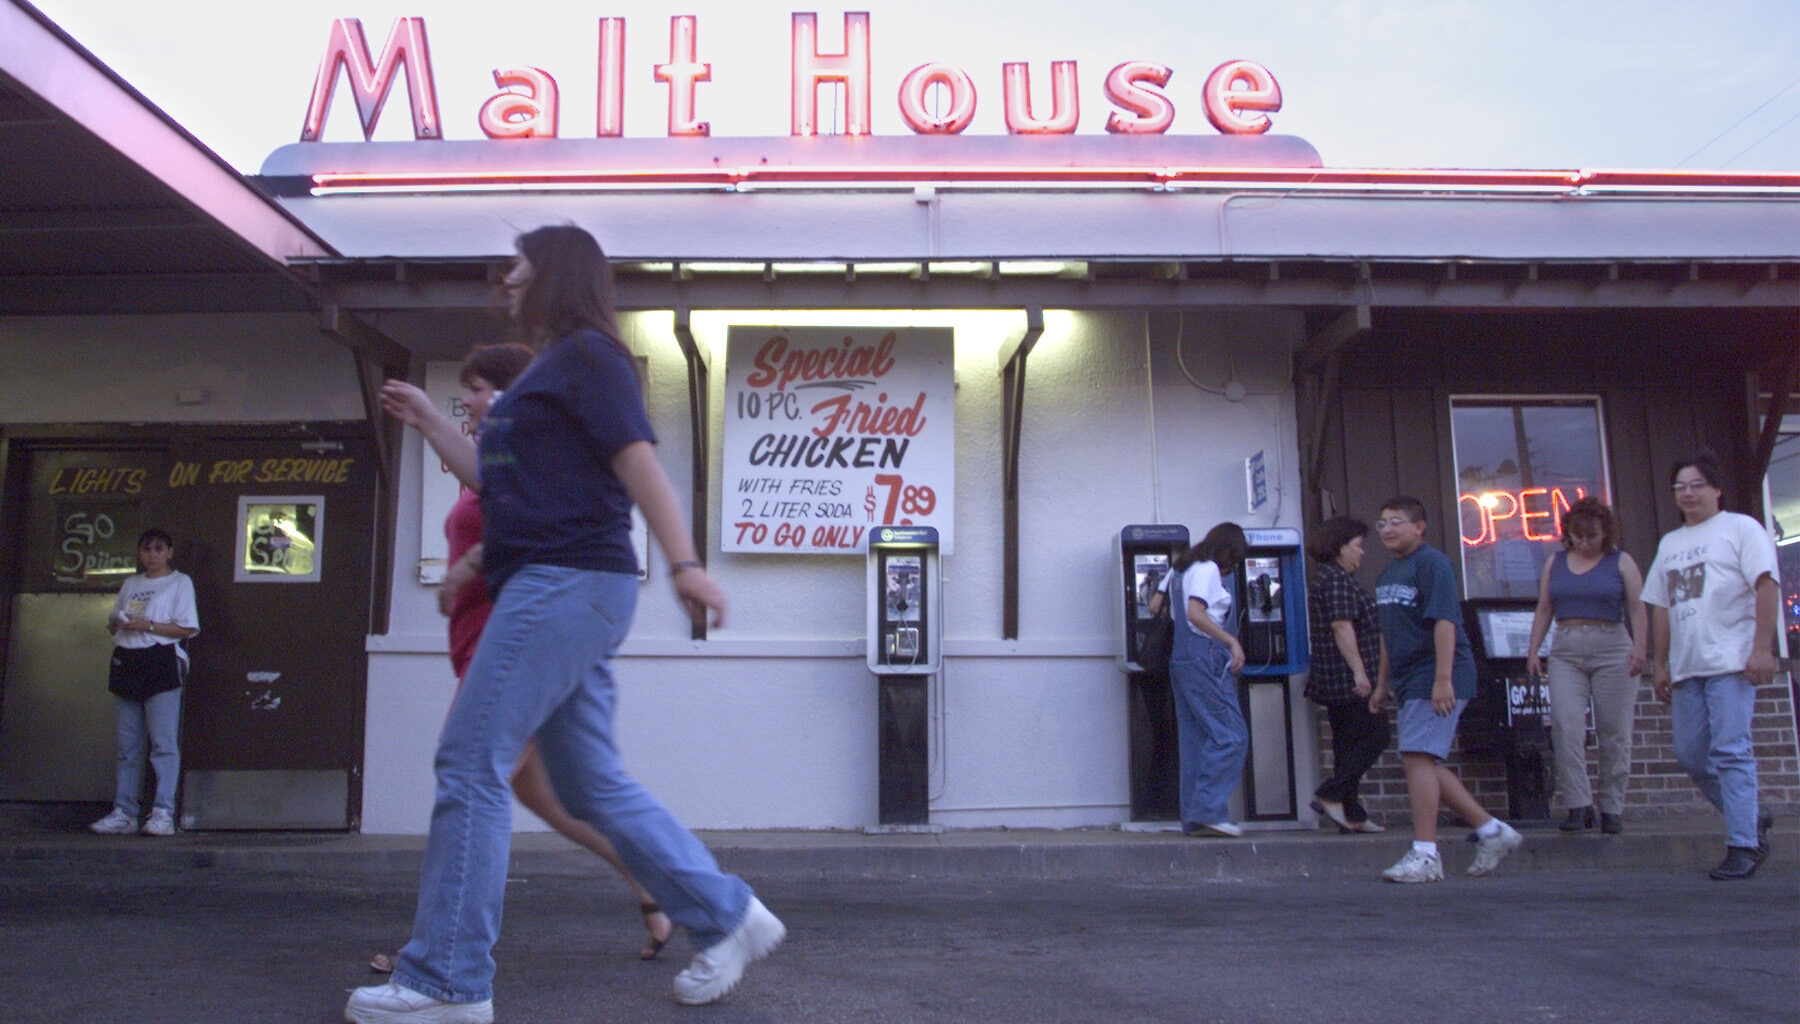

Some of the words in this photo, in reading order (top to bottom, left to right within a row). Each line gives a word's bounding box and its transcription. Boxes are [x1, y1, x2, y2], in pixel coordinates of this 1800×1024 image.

[300, 15, 712, 142] Malt
[790, 11, 1283, 136] House
[747, 331, 896, 391] Special
[737, 391, 760, 419] 10
[811, 391, 926, 437] Fried
[749, 433, 910, 468] CHICKEN
[48, 468, 147, 495] LIGHTS
[168, 462, 200, 487] ON
[208, 460, 254, 484] FOR
[254, 458, 354, 484] SERVICE
[738, 478, 781, 494] WITH
[789, 479, 843, 496] FRIES
[741, 499, 754, 518] 2
[760, 501, 811, 518] LITER
[815, 502, 852, 518] SODA
[735, 522, 767, 545] TO
[774, 522, 806, 547] GO
[811, 525, 865, 548] ONLY
[1248, 533, 1283, 542] Phone
